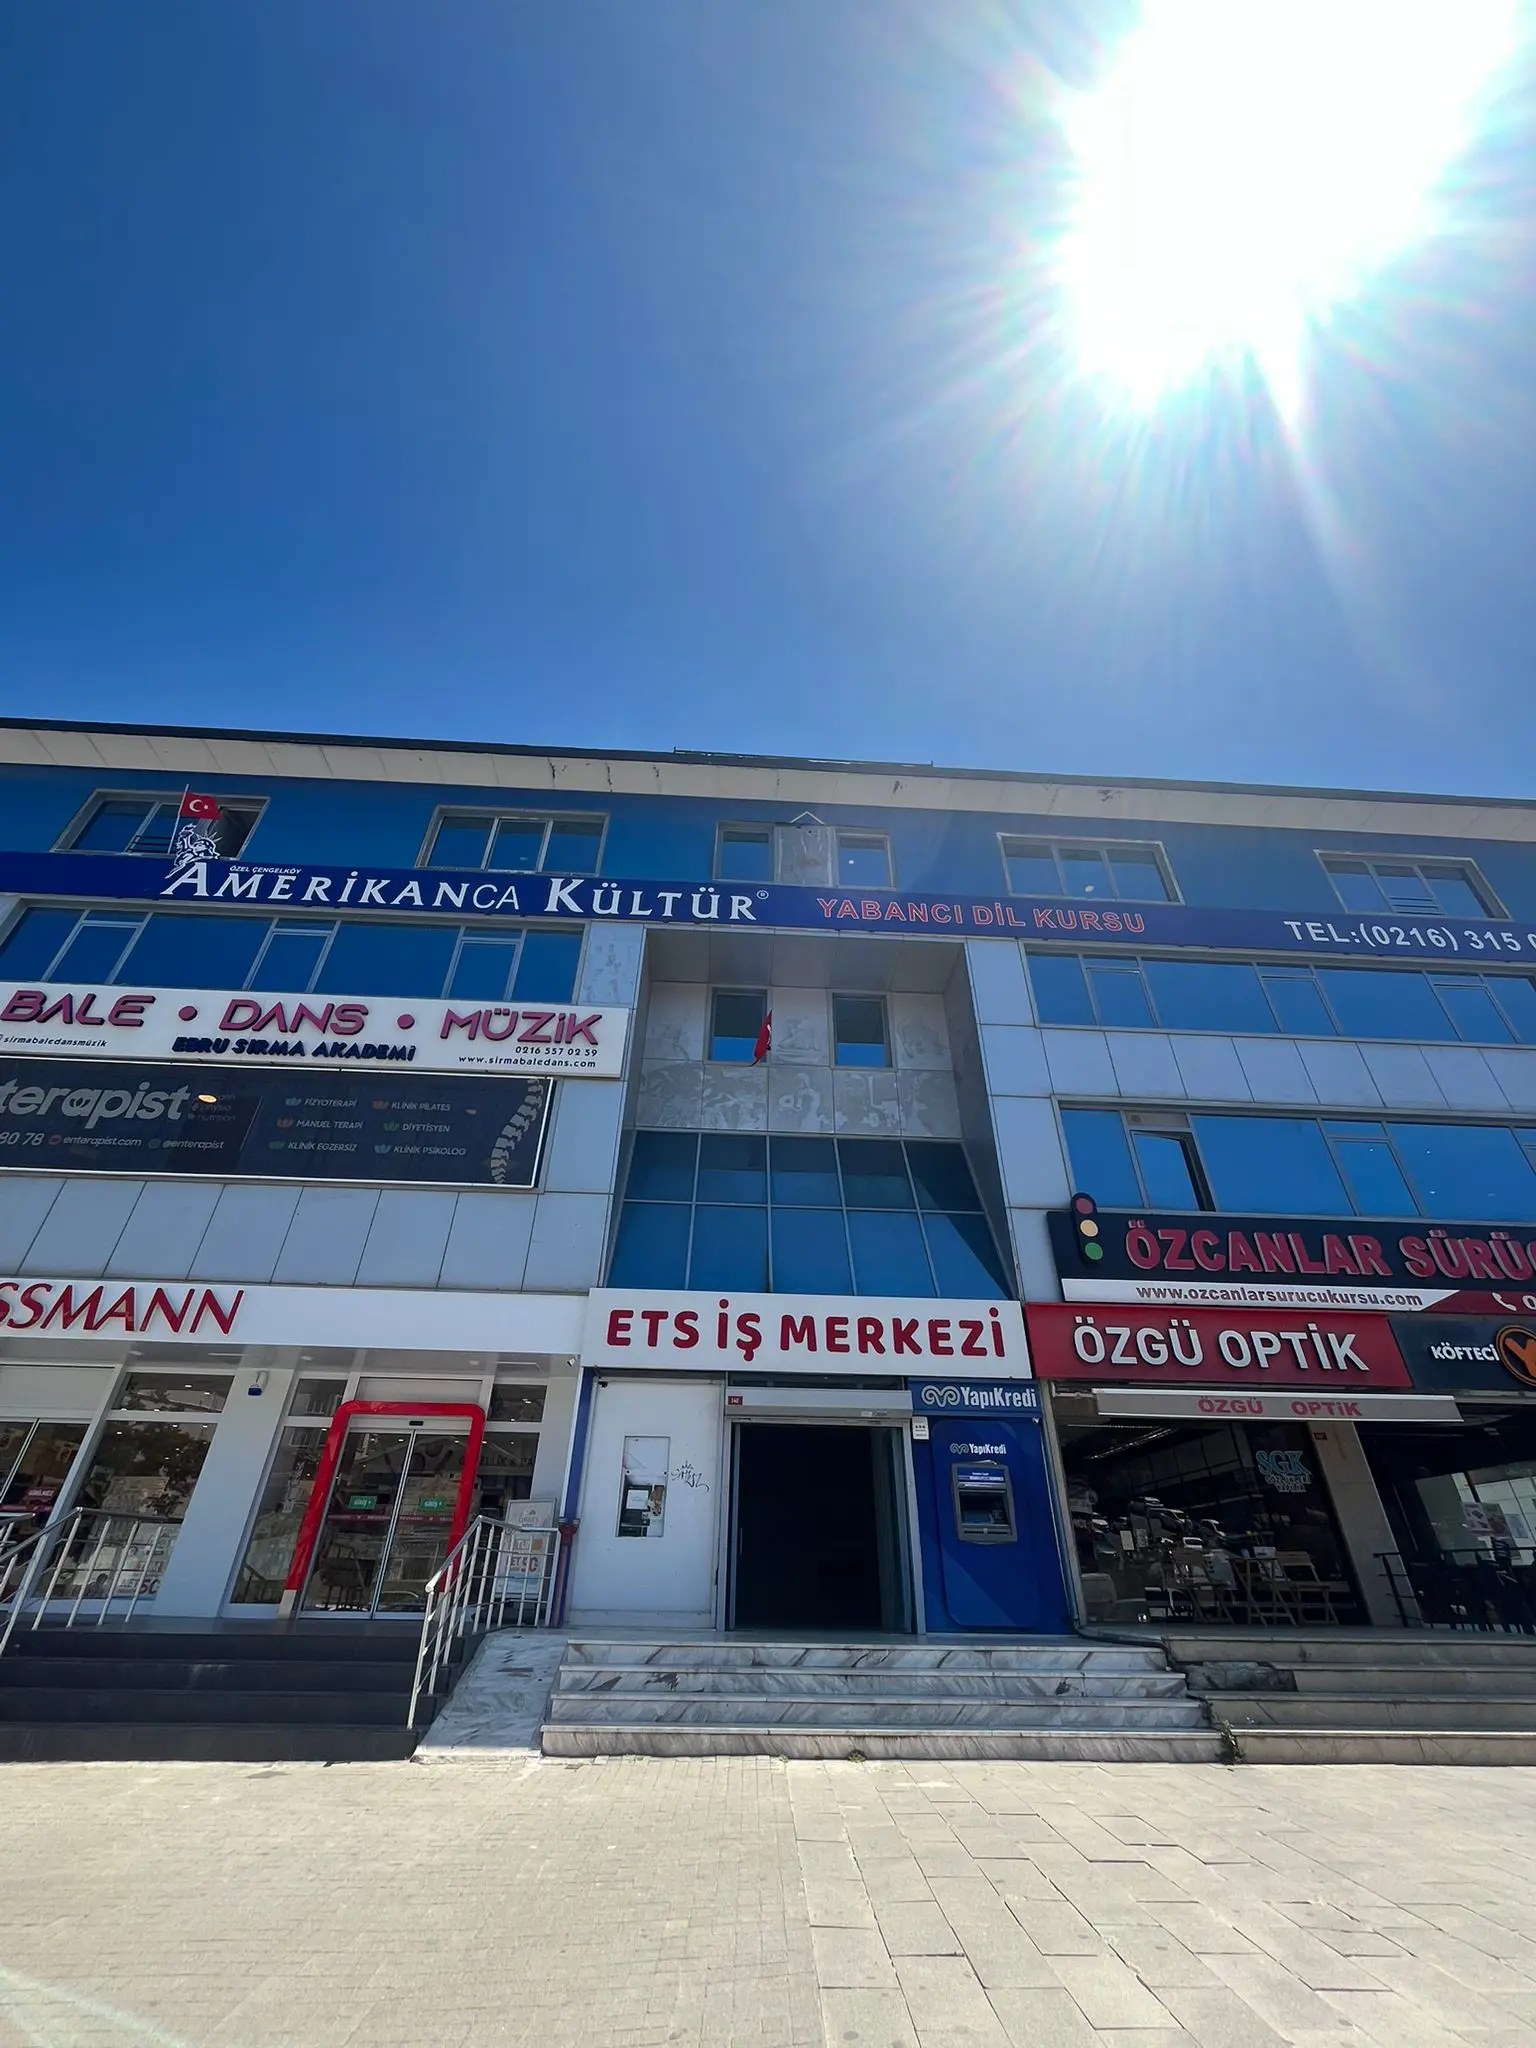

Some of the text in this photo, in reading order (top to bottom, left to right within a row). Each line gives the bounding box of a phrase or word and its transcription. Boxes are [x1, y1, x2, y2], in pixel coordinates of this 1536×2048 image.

[229, 865, 250, 873] ÖZEL
[816, 898, 1145, 933] YABANCI DİL KURSU
[1464, 930, 1521, 951] 315
[0, 990, 602, 1046] BALE DANS MÜZİK
[172, 1037, 230, 1053] EBRU
[311, 1041, 417, 1062] AKADEMİ
[515, 1046, 598, 1057] 0216 557 02 59
[22, 1132, 45, 1146] 78
[1126, 1219, 1536, 1281] ÖZCANLAR SÜRÜ
[606, 1298, 1006, 1361] ETS İŞ MERKEZİ
[1074, 1315, 1370, 1371] ÖZGÜ OPTİK
[1431, 1341, 1500, 1361] KÖFTECİ
[1198, 1396, 1363, 1417] ÖZGÜ OPTİK
